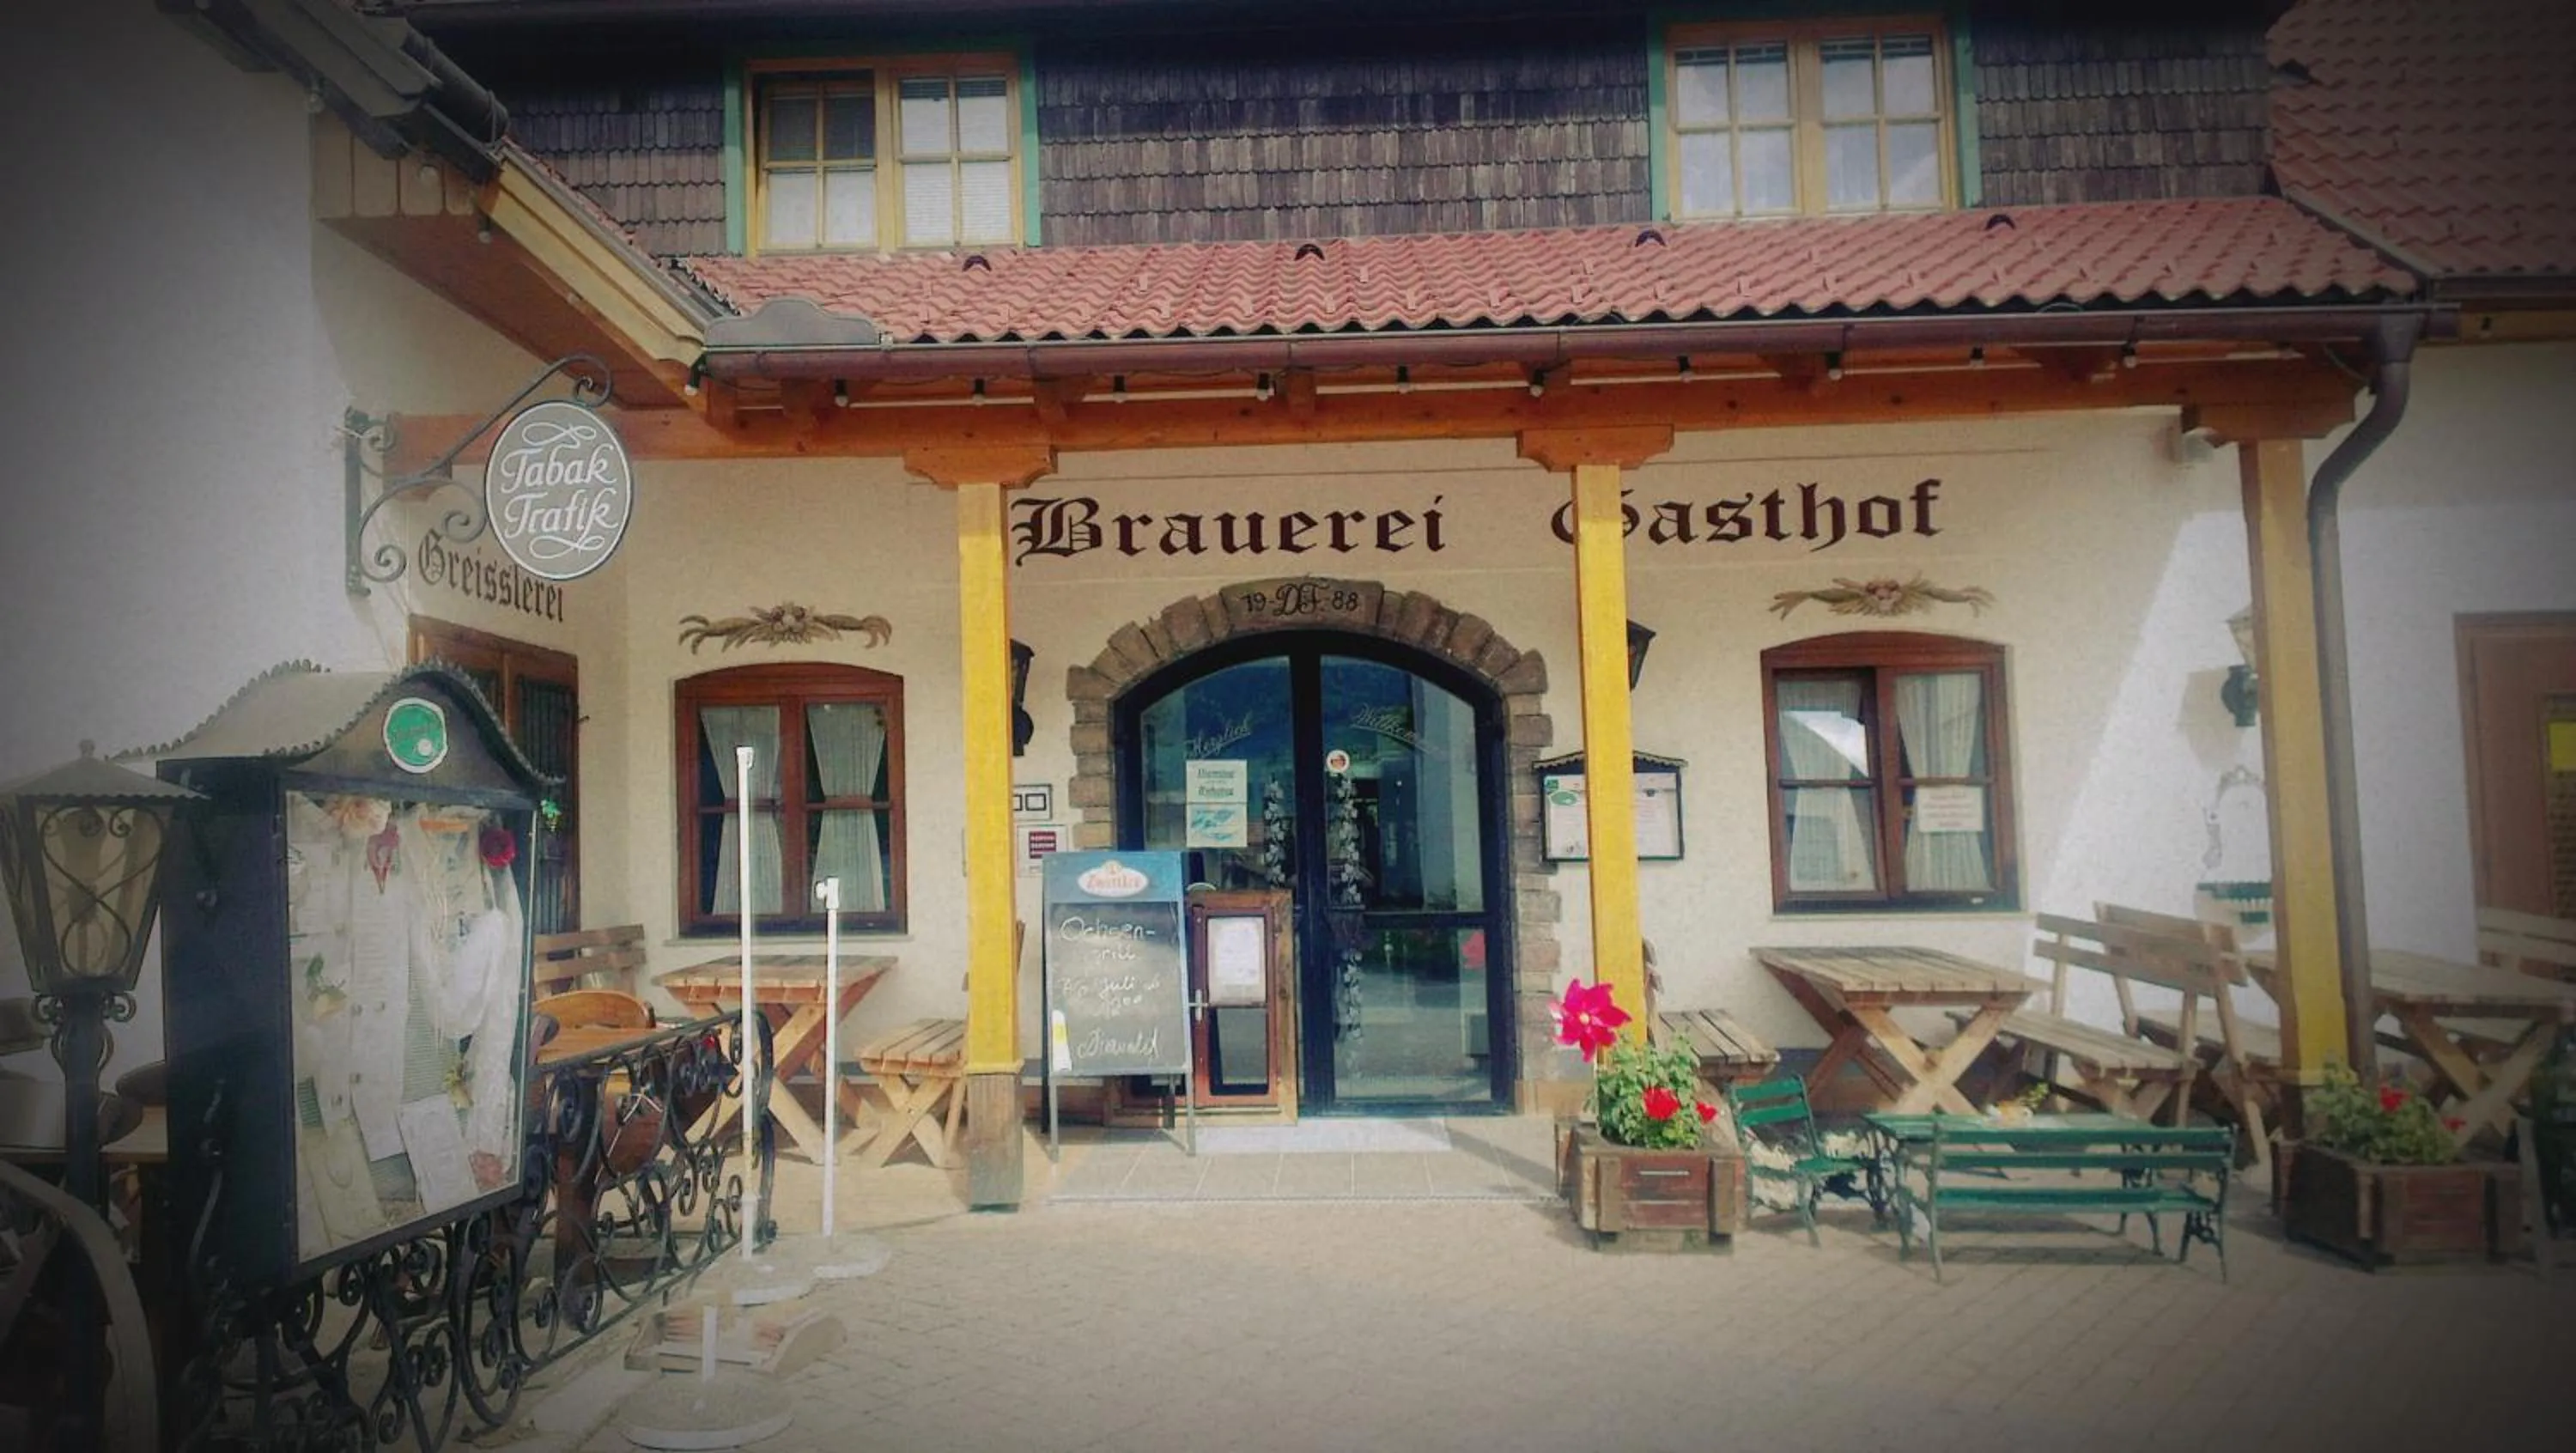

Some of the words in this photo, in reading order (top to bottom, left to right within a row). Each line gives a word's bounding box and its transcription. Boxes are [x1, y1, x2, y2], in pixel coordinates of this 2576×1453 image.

[501, 442, 617, 494] Tabak
[505, 488, 619, 540] Trafik
[1010, 494, 1446, 567] Brauerei
